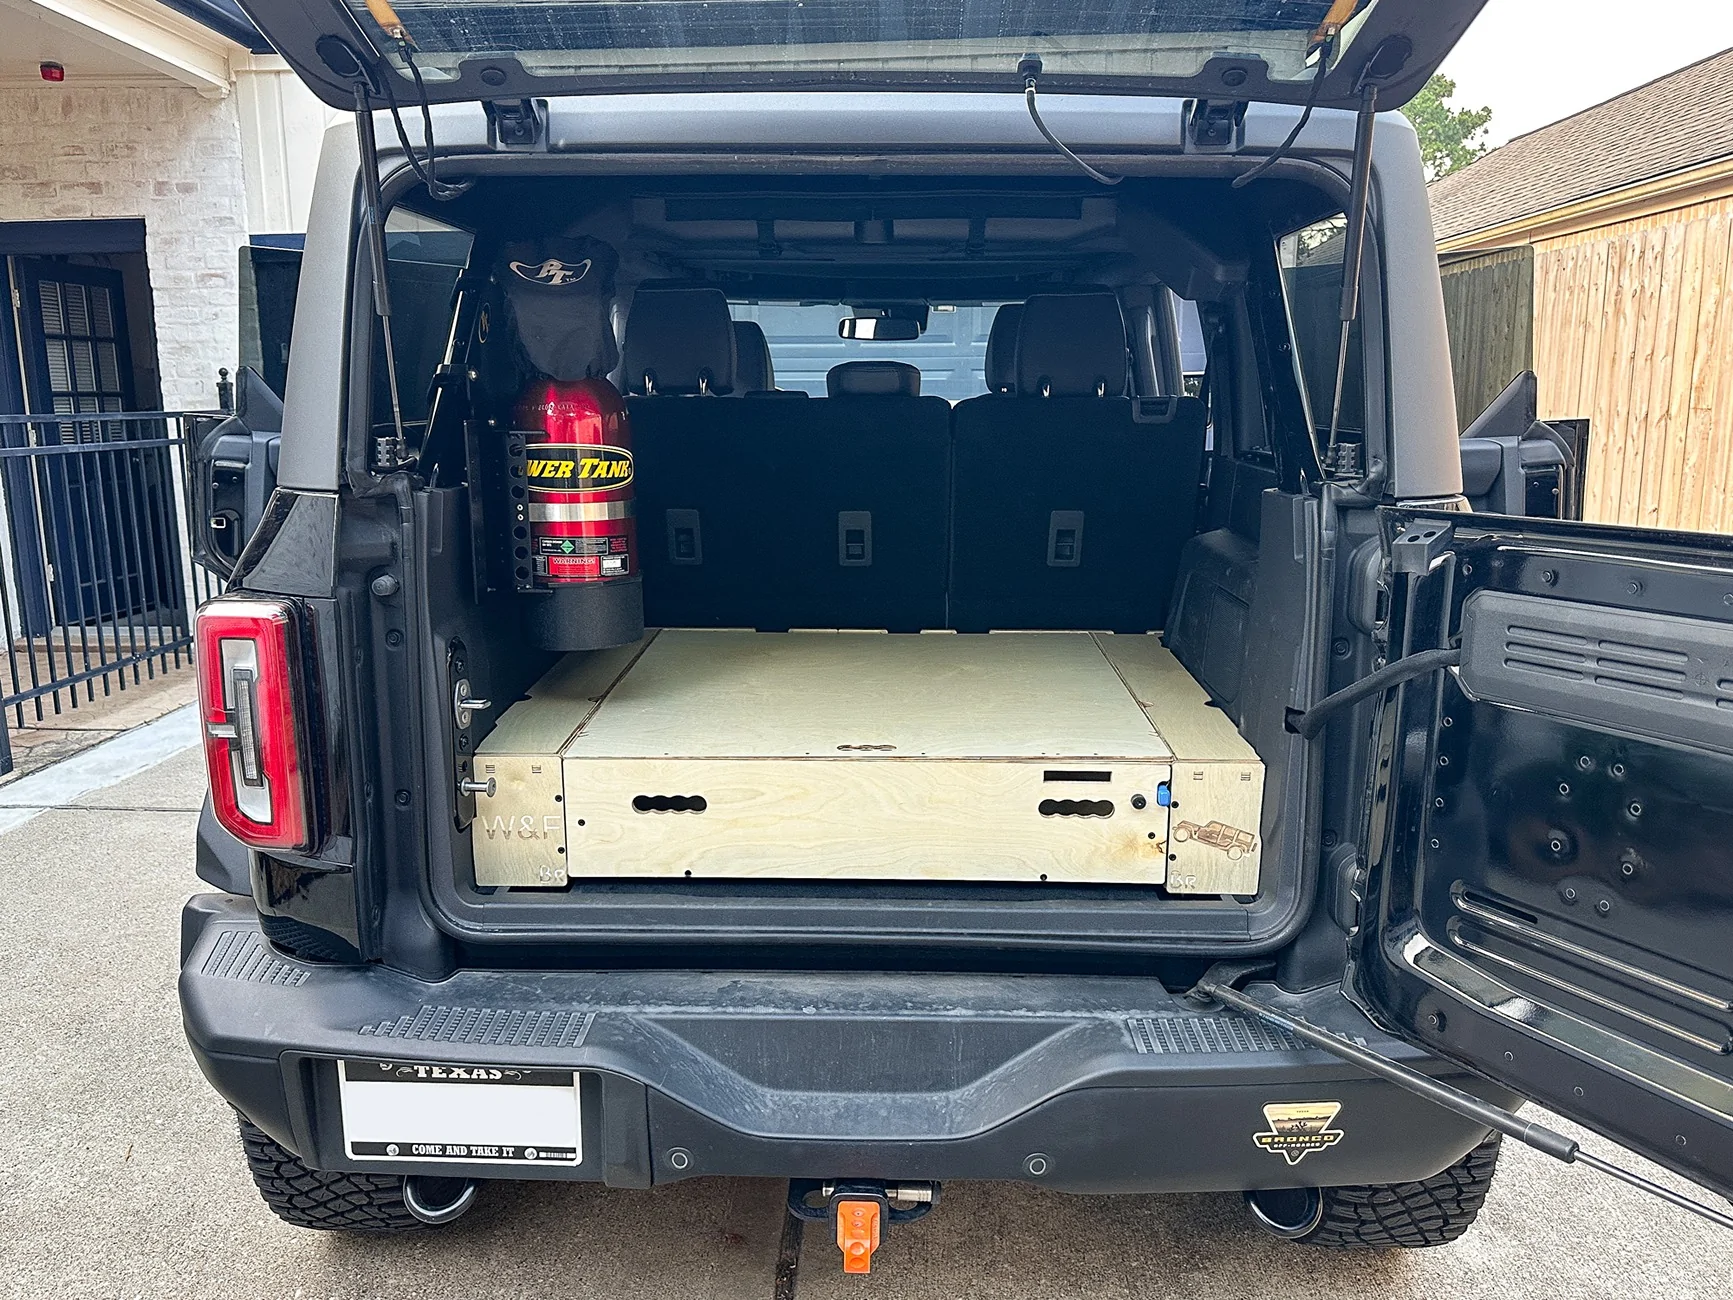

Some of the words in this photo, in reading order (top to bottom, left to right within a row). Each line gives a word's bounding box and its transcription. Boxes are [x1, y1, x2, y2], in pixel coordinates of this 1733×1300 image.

[526, 460, 575, 478] WER
[578, 457, 630, 479] TANK
[553, 557, 595, 565] WARNING!
[481, 815, 562, 840] W&F
[413, 1065, 503, 1080] TEXAS
[1261, 1134, 1335, 1144] BRONCO
[411, 1144, 443, 1155] COME
[445, 1145, 468, 1156] AND
[470, 1146, 499, 1157] TAKE
[501, 1147, 515, 1157] IT
